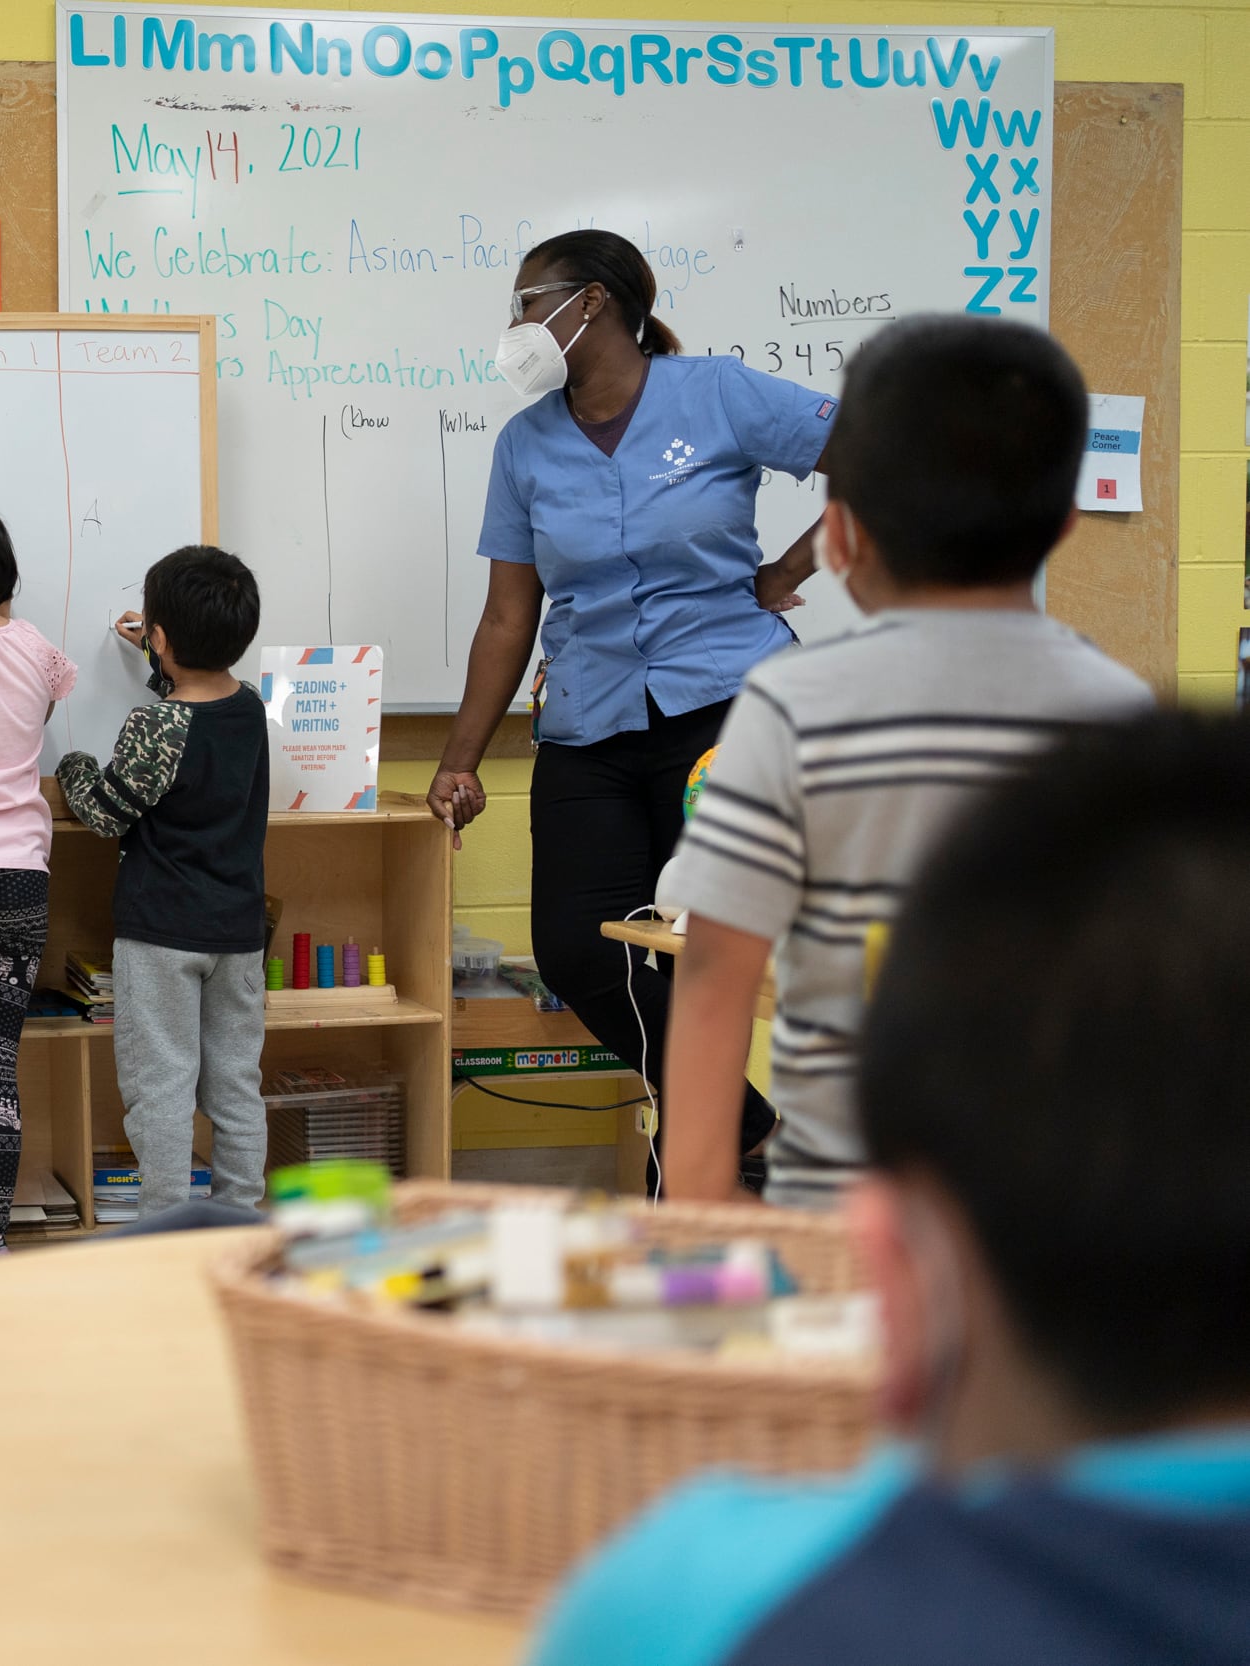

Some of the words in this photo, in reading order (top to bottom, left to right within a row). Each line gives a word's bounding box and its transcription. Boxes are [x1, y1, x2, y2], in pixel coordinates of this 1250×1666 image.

[142, 17, 255, 73] Mm
[269, 21, 352, 77] Nn
[362, 25, 453, 80] Oo
[459, 28, 535, 108] Pp
[537, 29, 625, 96] Qq
[630, 34, 703, 85] Rr
[706, 34, 779, 88] Ss
[773, 37, 843, 89] Tt
[849, 37, 927, 88] Uu
[927, 37, 1001, 92] Vv
[931, 97, 1042, 149] Ww
[111, 123, 201, 219] May
[278, 124, 361, 172] 2021
[85, 229, 137, 280] We
[153, 225, 333, 279] Celebrate:
[350, 214, 534, 273] Asian-Pacif
[779, 282, 892, 318] Numbers
[263, 298, 323, 361] Day
[29, 341, 39, 365] 1
[77, 340, 159, 364] Team
[170, 341, 191, 363] 2
[764, 342, 784, 373] 3
[796, 343, 814, 377] 4
[826, 340, 845, 372] 5
[268, 348, 455, 401] Appreciation
[1091, 440, 1122, 451] Corner
[1093, 432, 1120, 442] Peace
[1103, 484, 1111, 494] 1
[80, 498, 103, 538] A
[295, 700, 327, 714] MATH
[329, 701, 337, 710] +
[291, 718, 340, 733] WRITING
[282, 744, 302, 752] PLEASE
[302, 744, 317, 752] WEAR
[454, 1056, 502, 1066] CLASSROOM
[516, 1050, 579, 1067] magnetic
